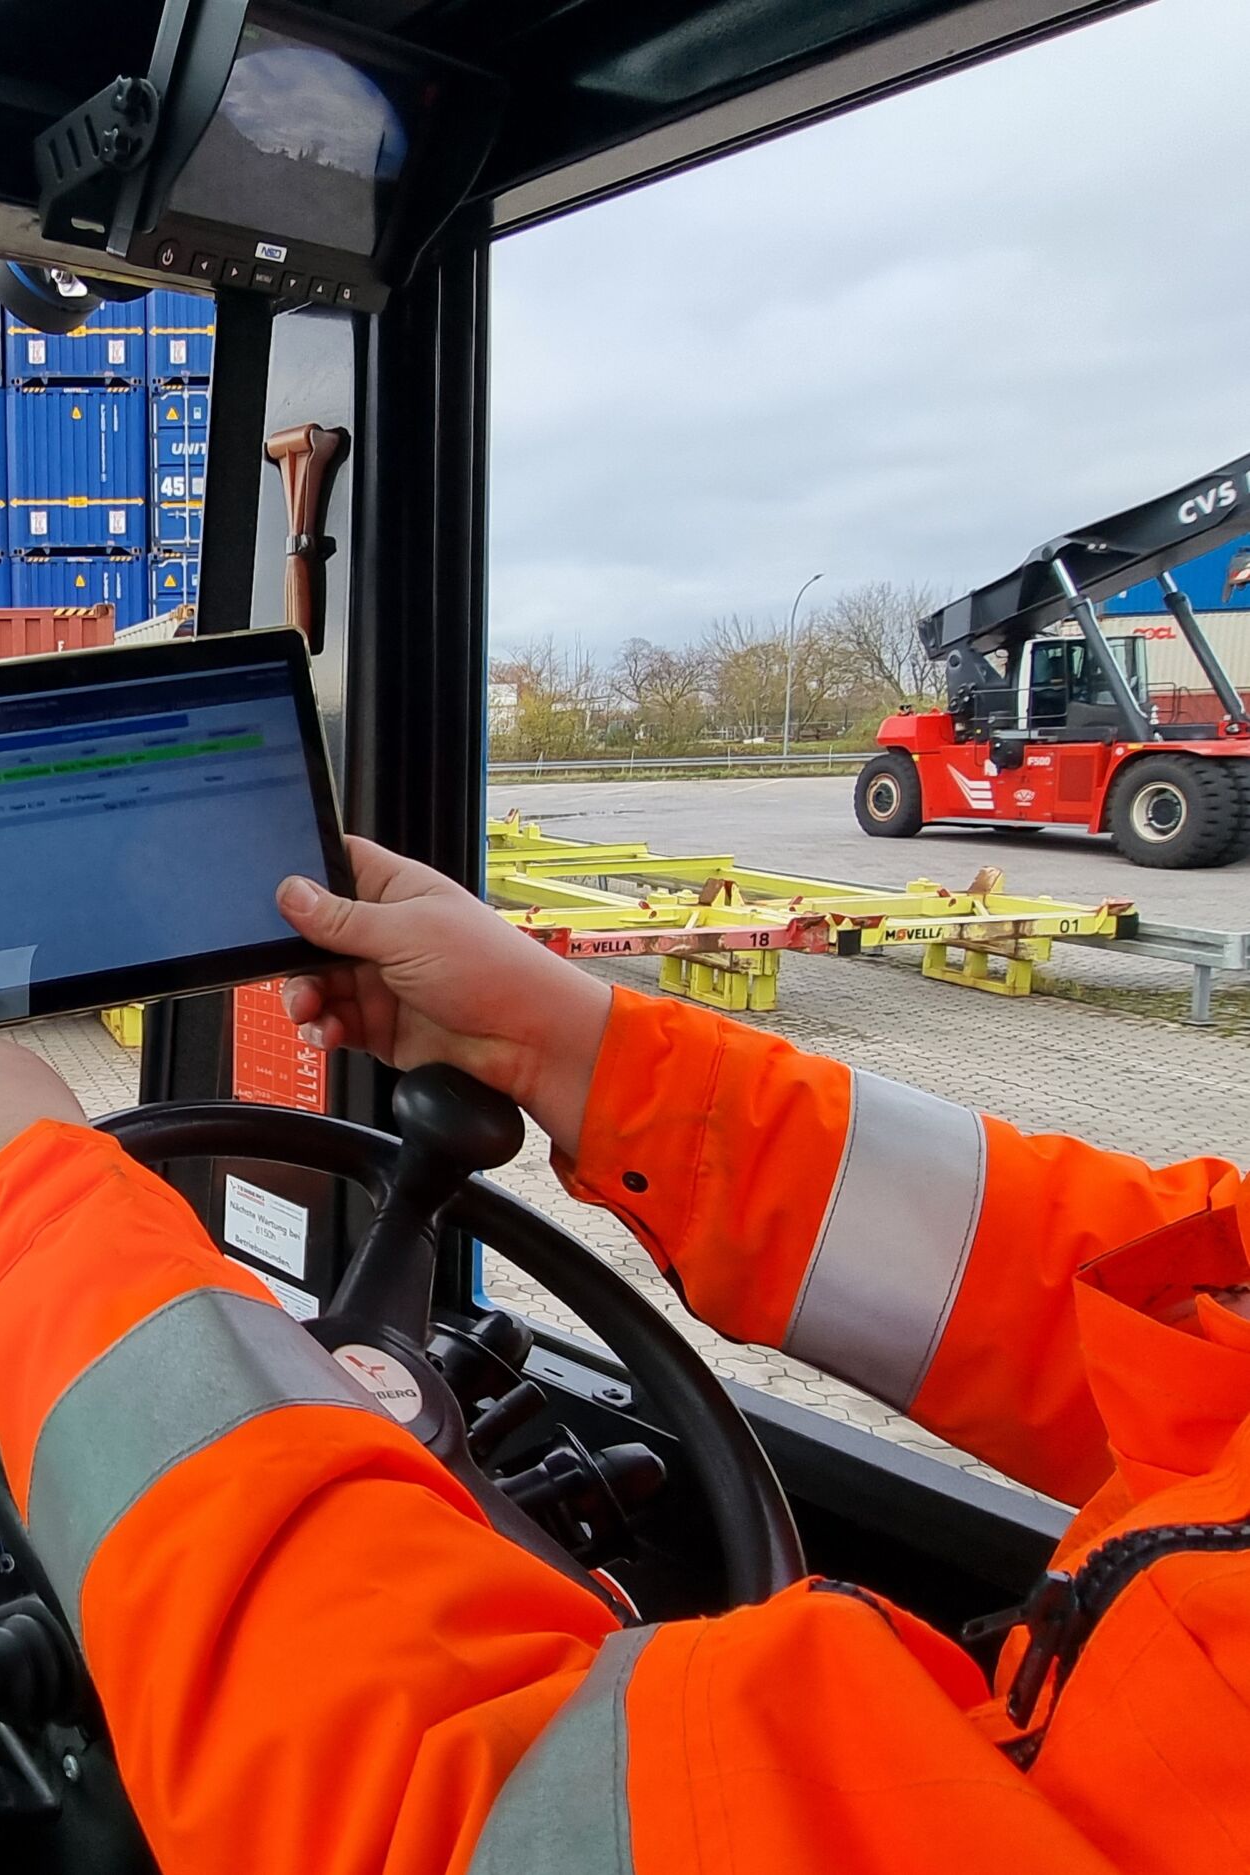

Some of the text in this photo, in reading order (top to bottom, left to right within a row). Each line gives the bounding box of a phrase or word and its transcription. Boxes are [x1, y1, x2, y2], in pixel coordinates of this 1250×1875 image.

[160, 477, 184, 496] 45
[1177, 480, 1237, 524] CVS
[1060, 919, 1079, 934] 01
[571, 940, 632, 954] MOVELLA
[750, 933, 770, 948] 18
[229, 1200, 256, 1219] Nächste
[258, 1214, 288, 1237] Wartung
[289, 1228, 301, 1241] bei
